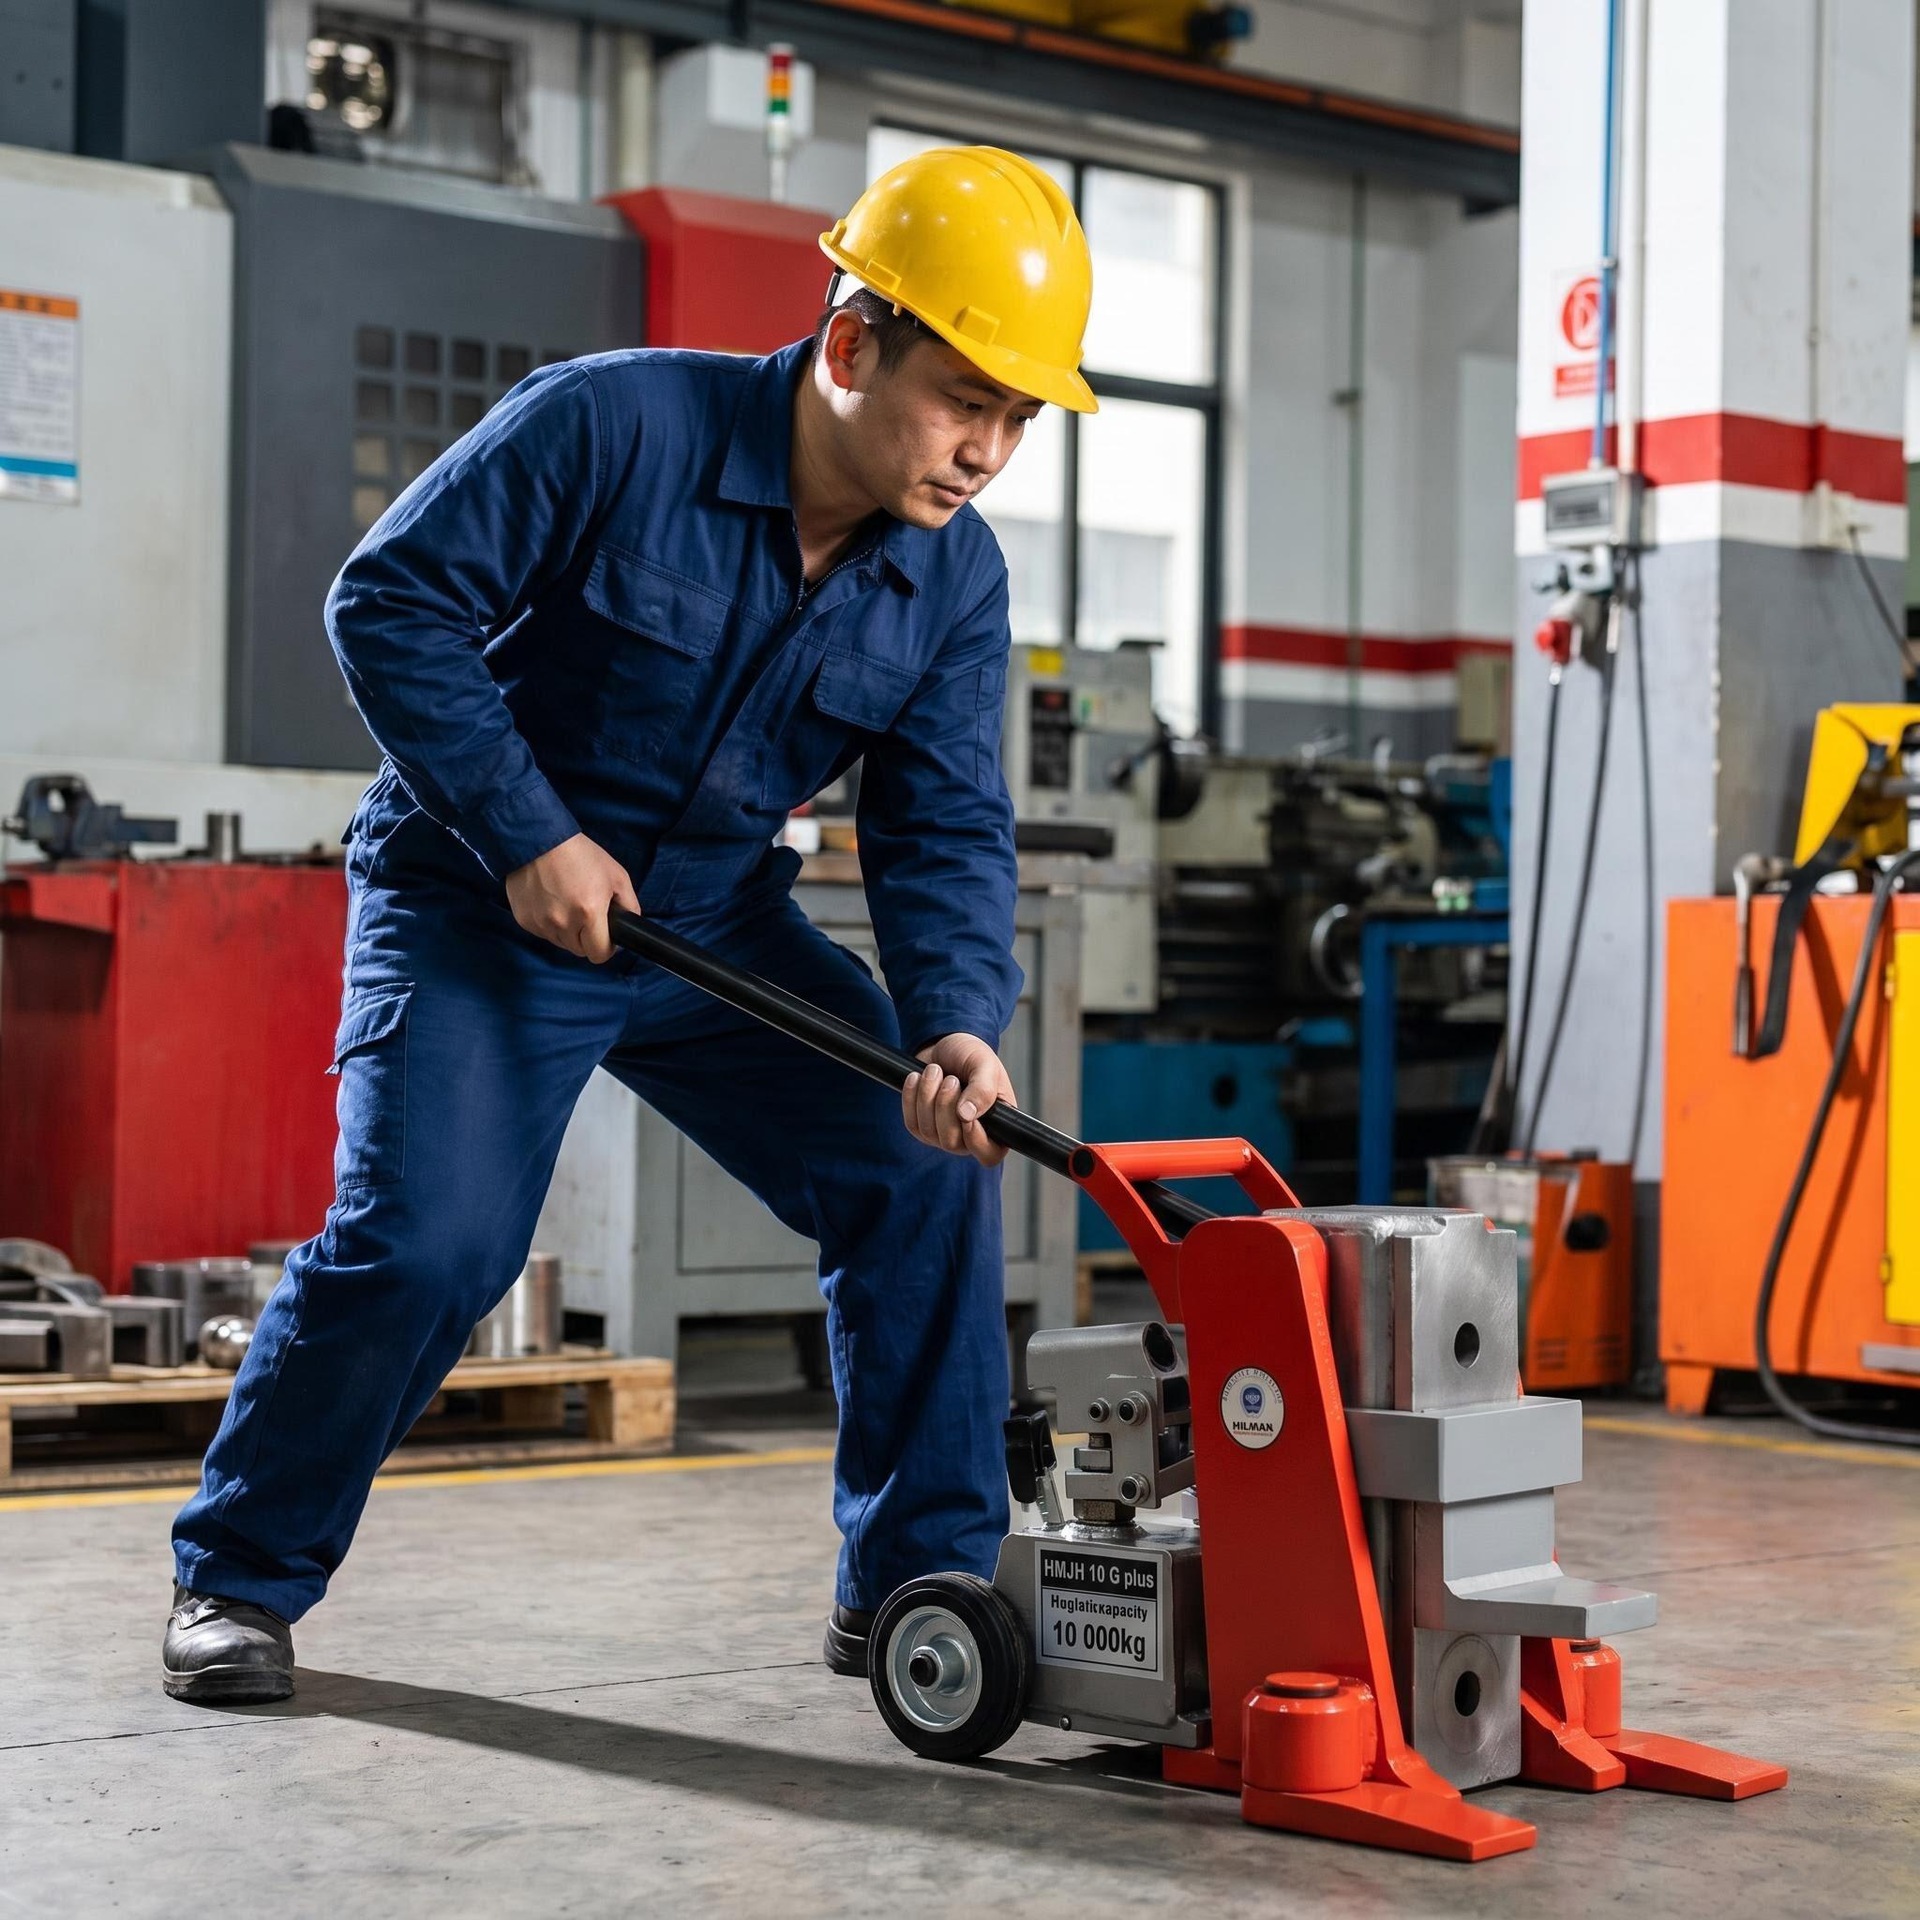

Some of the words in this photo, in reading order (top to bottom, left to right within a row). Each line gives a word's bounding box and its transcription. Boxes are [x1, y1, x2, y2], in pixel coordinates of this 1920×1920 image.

[1232, 1421, 1274, 1432] HILMAN
[1044, 1559, 1085, 1581] HMJH
[1089, 1564, 1105, 1583] 10
[1109, 1566, 1120, 1585] G
[1124, 1569, 1155, 1590] plus
[1053, 1620, 1077, 1647] 10
[1083, 1624, 1145, 1662] 000kg
